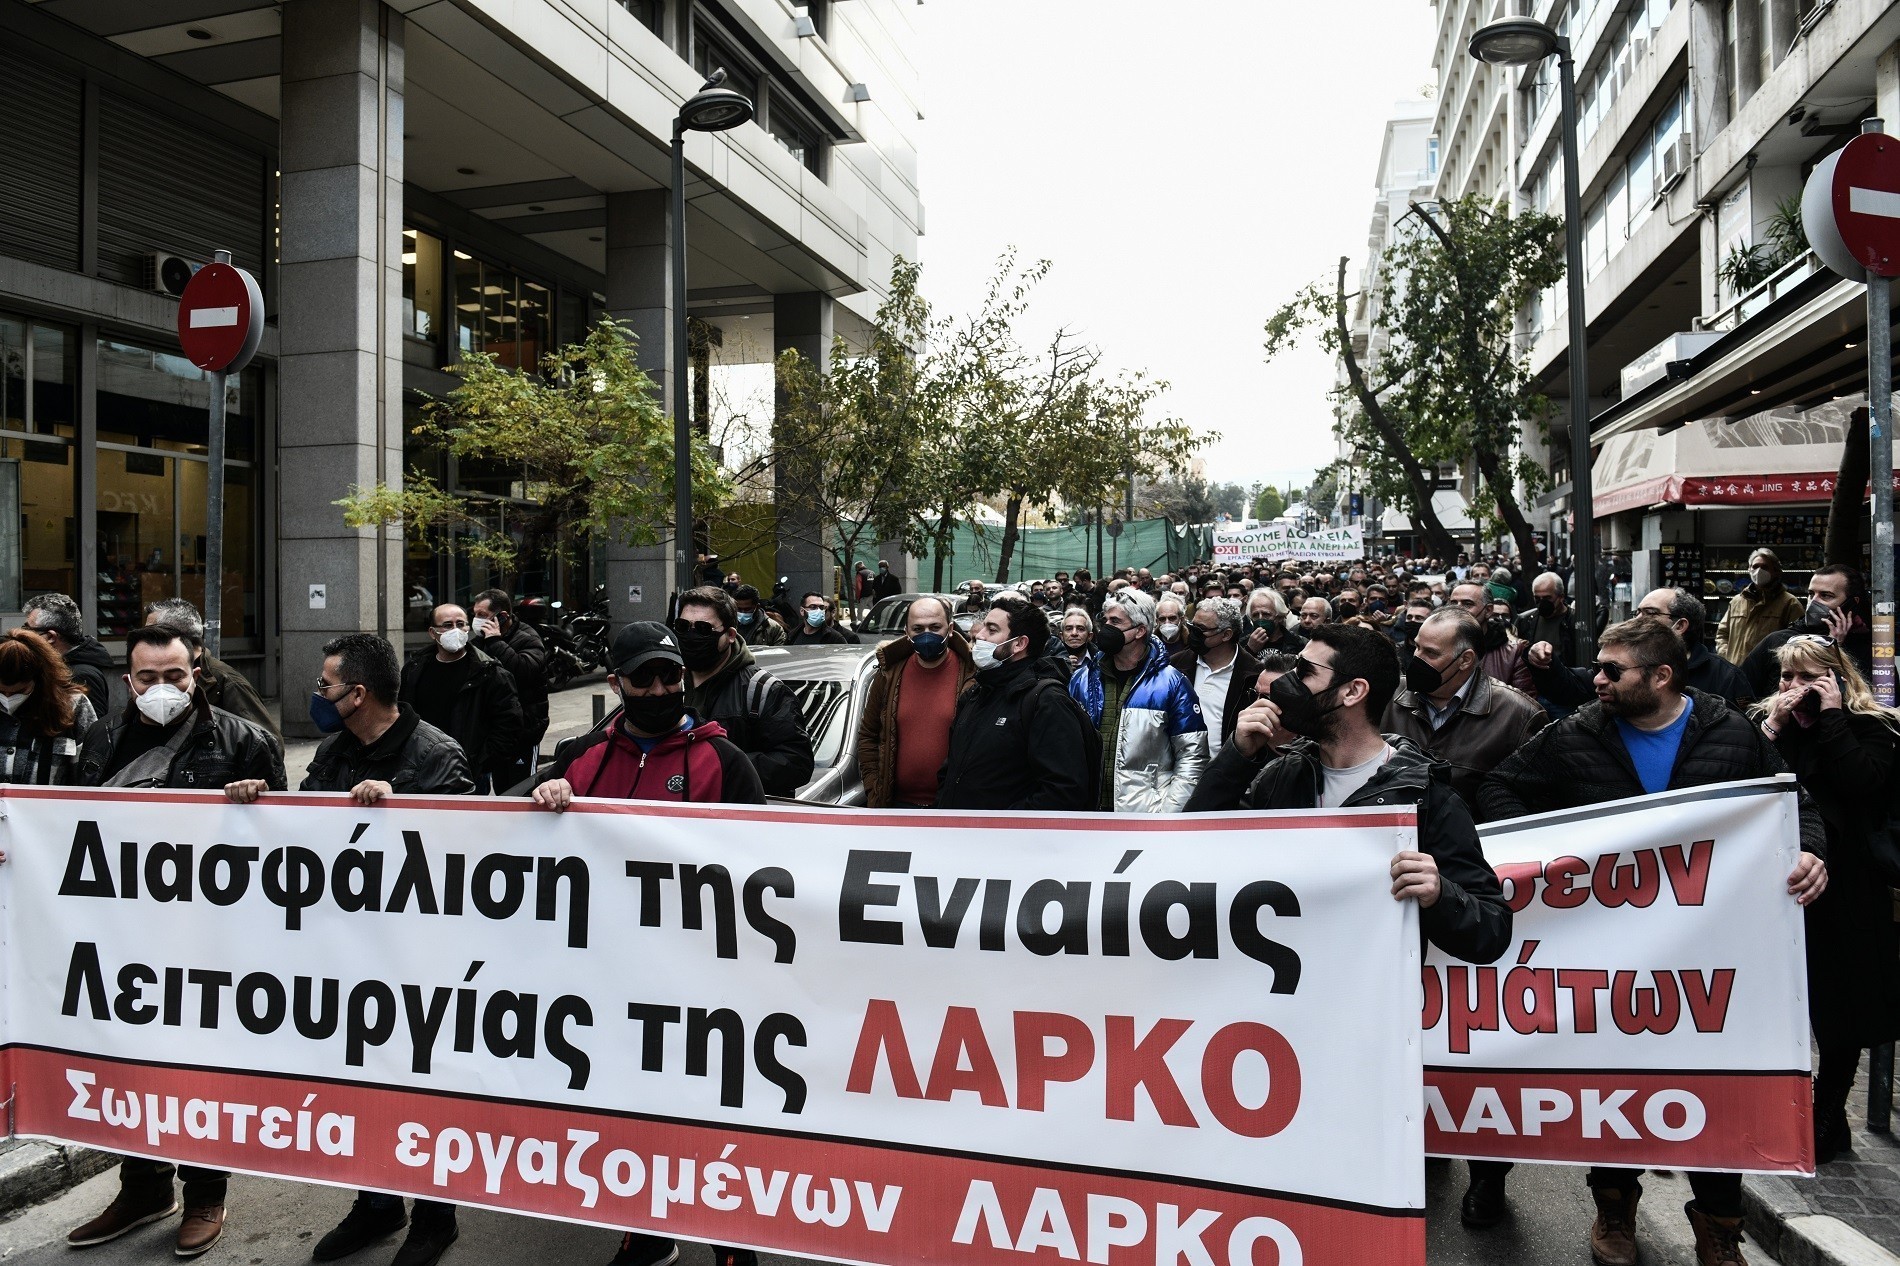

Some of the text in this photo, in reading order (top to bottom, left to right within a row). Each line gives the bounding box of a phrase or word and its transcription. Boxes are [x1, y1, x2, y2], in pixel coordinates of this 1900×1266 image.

[1698, 483, 1754, 496] 京品食尚
[1759, 483, 1783, 492] JING
[1215, 546, 1236, 554] ΟΧΙ
[1241, 541, 1306, 553] ΕΠΙΔΟΜΑΤΑ
[1217, 528, 1352, 543] ΘΕΛΟΥΜΕ ΔΟΕΙΑ
[58, 820, 1303, 995] Διασφάλιση της Ενιαίας
[1493, 839, 1716, 914] σεων
[1422, 940, 1737, 1055] μάτων
[61, 941, 1302, 1139] Λειτουργίας της ΛΑΡΚΟ
[1423, 1085, 1707, 1143] ΛΑΡΚΟ
[65, 1068, 1305, 1266] Σωματεία εργαζομένων ΛΑΡΚΟ
